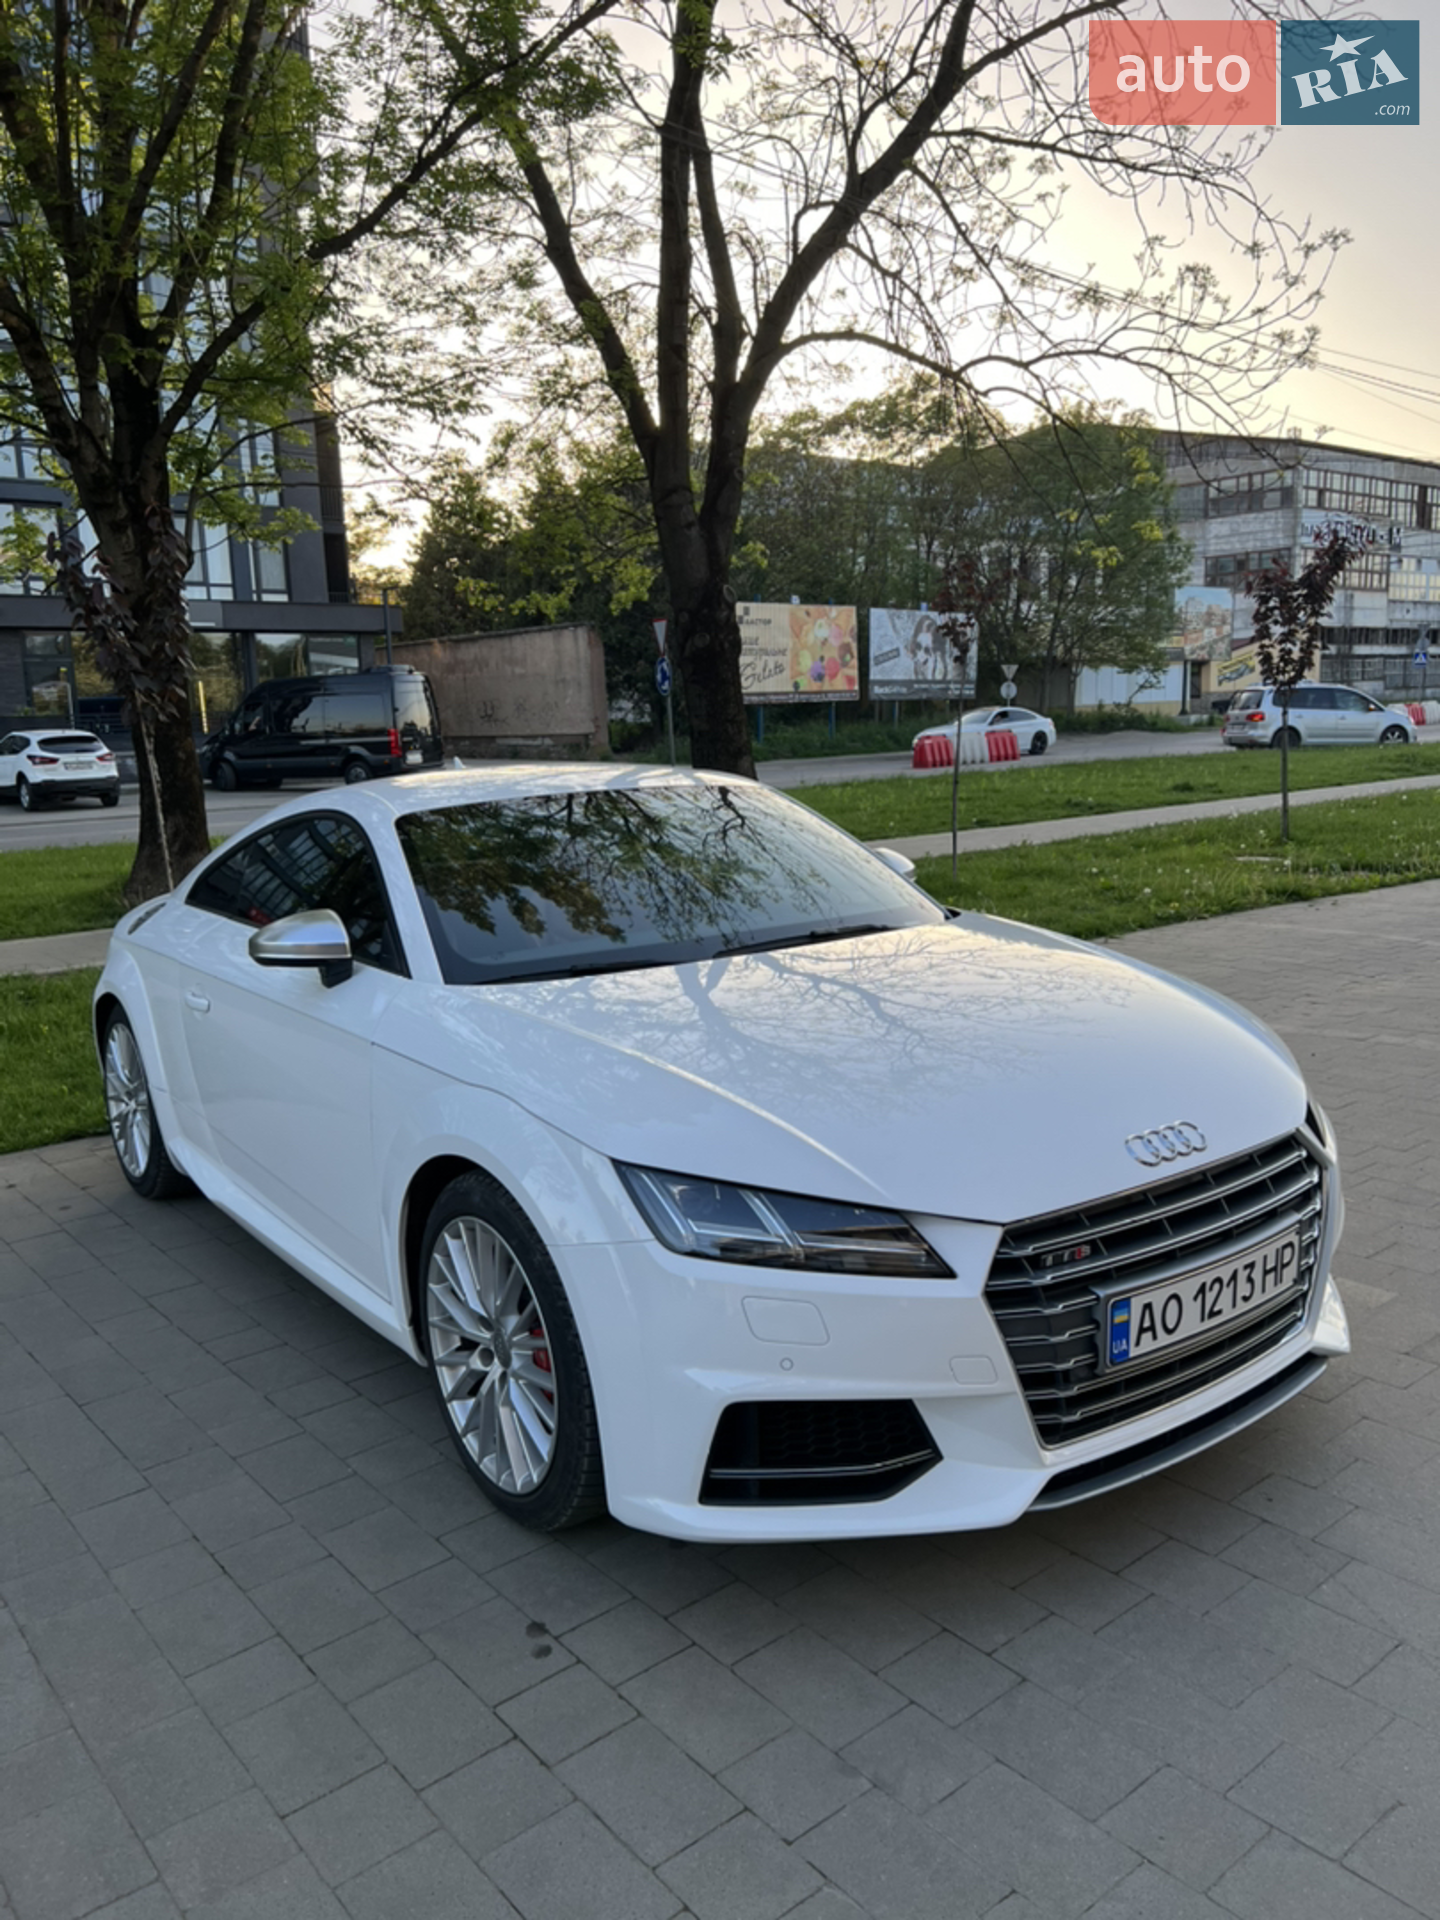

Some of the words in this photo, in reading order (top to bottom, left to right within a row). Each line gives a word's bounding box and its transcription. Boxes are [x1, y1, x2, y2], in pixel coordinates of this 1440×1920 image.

[1134, 1292, 1183, 1348] AO
[1193, 1260, 1256, 1323] 1213
[1261, 1240, 1296, 1294] HP
[1112, 1338, 1129, 1354] UA
